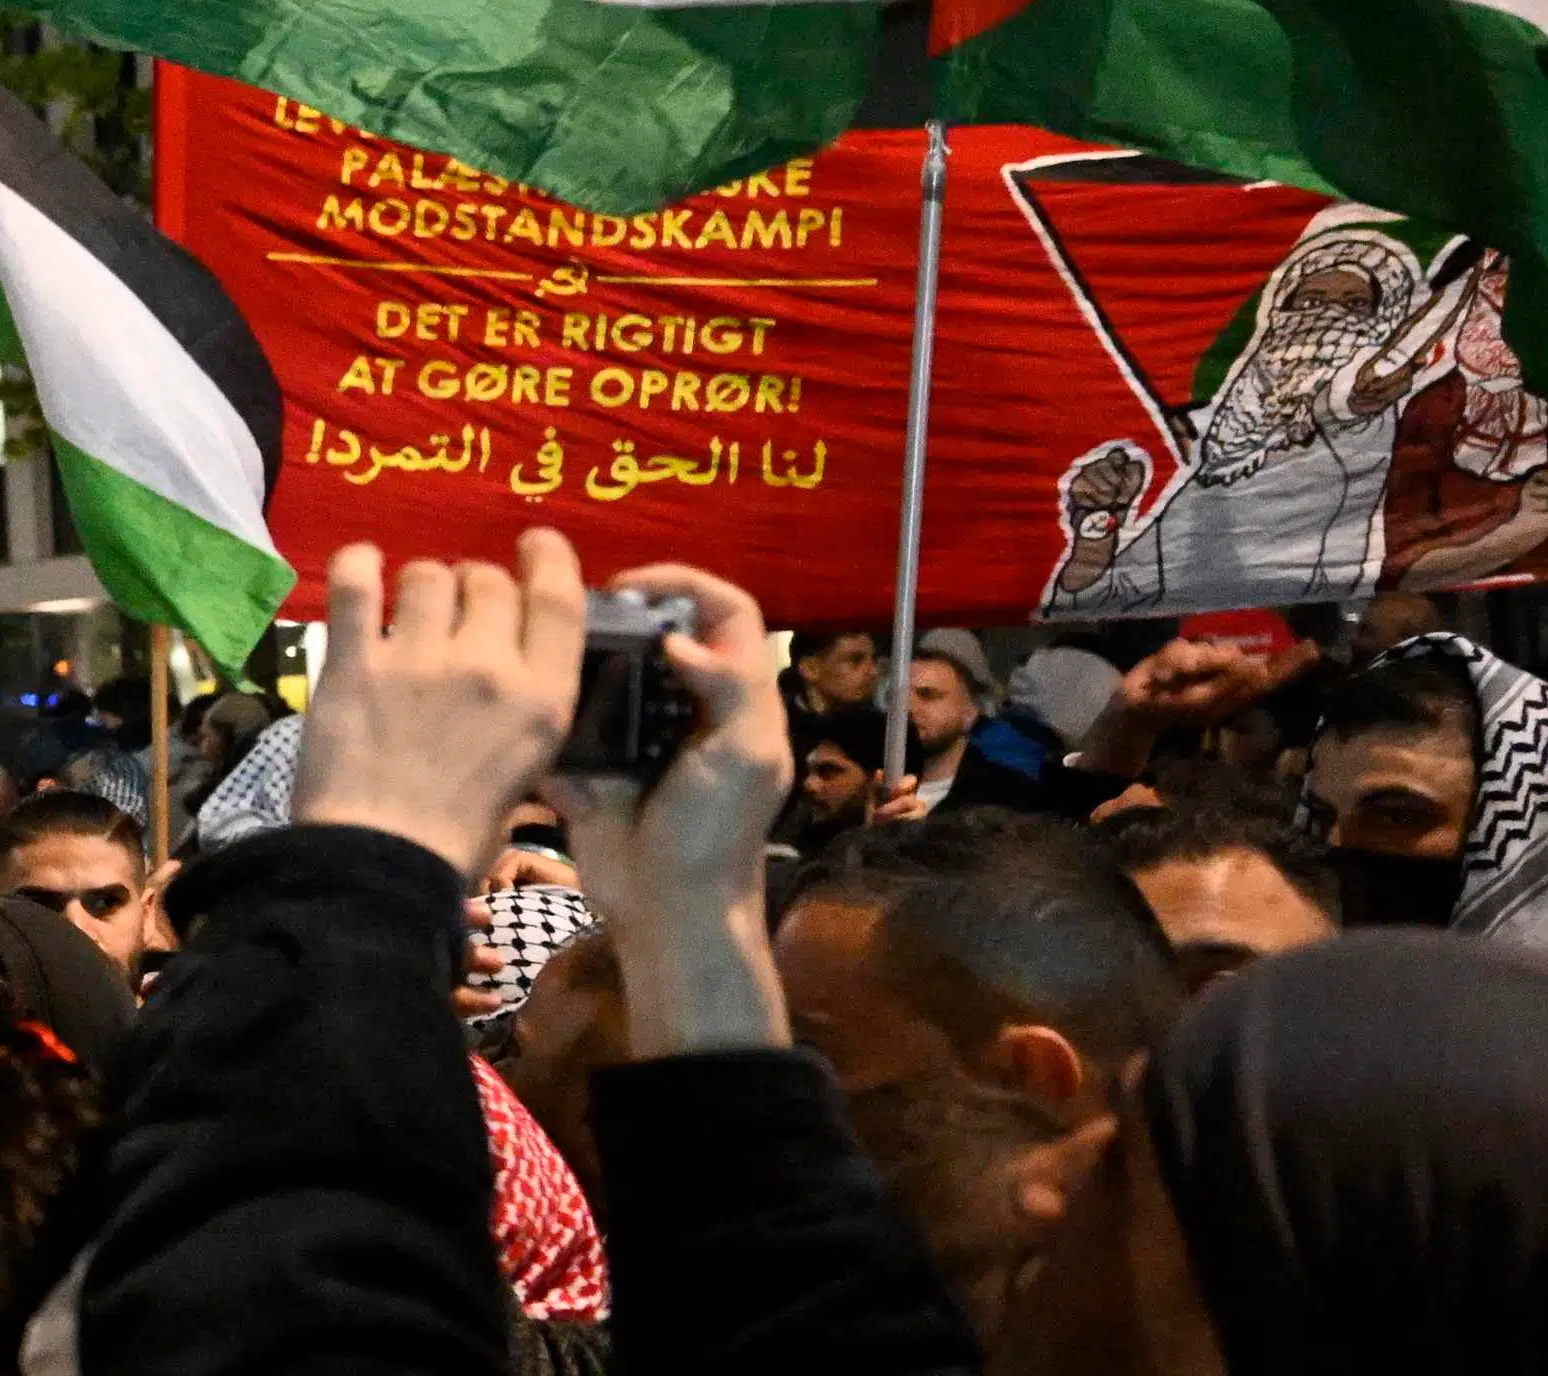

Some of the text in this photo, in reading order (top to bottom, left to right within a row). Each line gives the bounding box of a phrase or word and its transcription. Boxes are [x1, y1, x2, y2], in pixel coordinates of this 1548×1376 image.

[375, 301, 777, 355] DET ER RIGTIGT
[336, 355, 802, 413] AT GØRE OPRØR!
[508, 426, 564, 503] في
[584, 435, 740, 501] الحق
[761, 438, 827, 490] لنا
